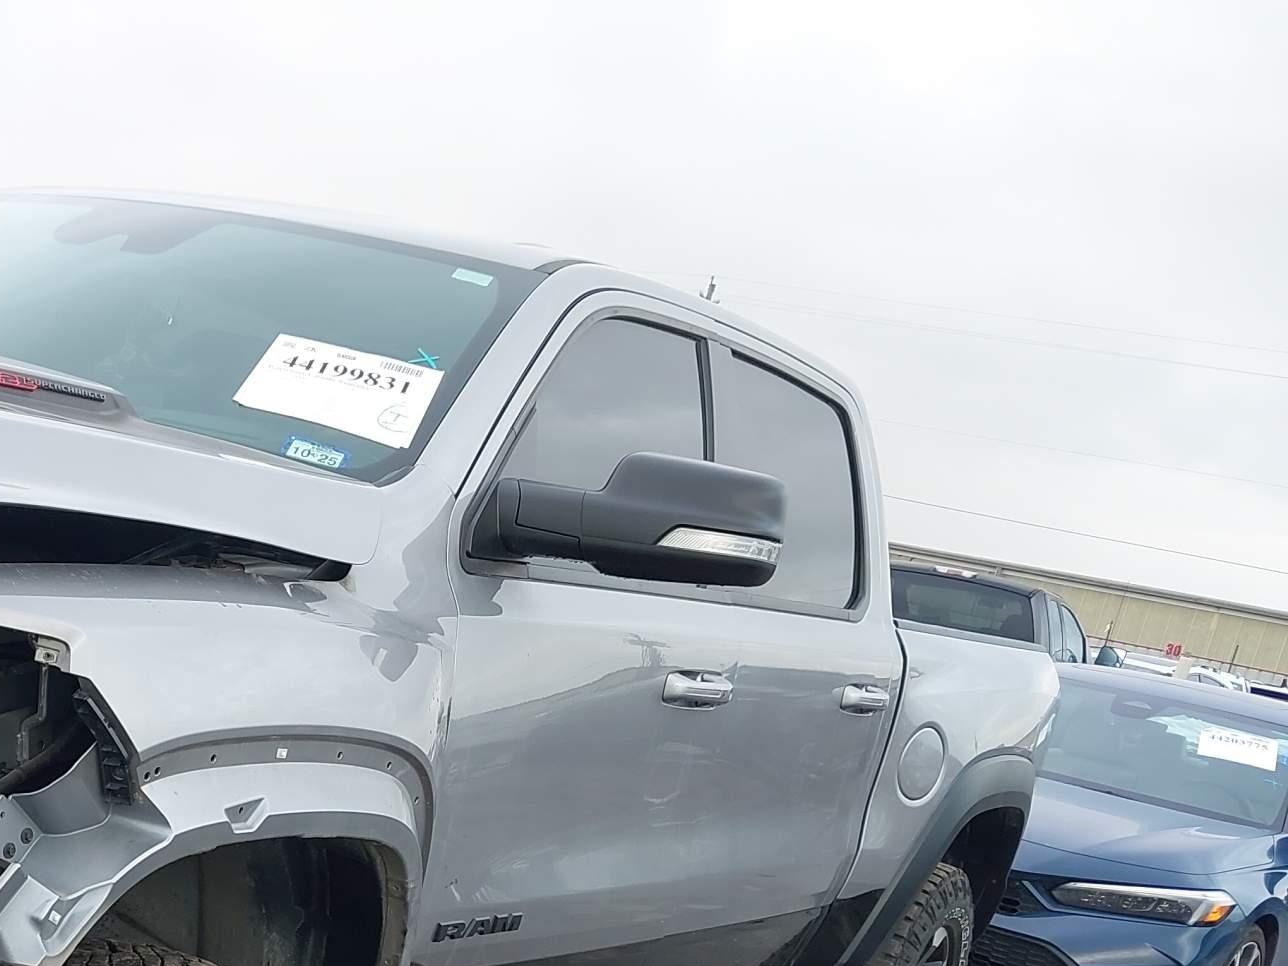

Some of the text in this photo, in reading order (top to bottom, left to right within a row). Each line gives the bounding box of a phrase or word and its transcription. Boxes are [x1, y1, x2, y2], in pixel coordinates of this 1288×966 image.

[281, 355, 411, 395] 44199831
[317, 453, 338, 466] 25
[1165, 643, 1182, 657] 30
[431, 912, 523, 943] RAM
